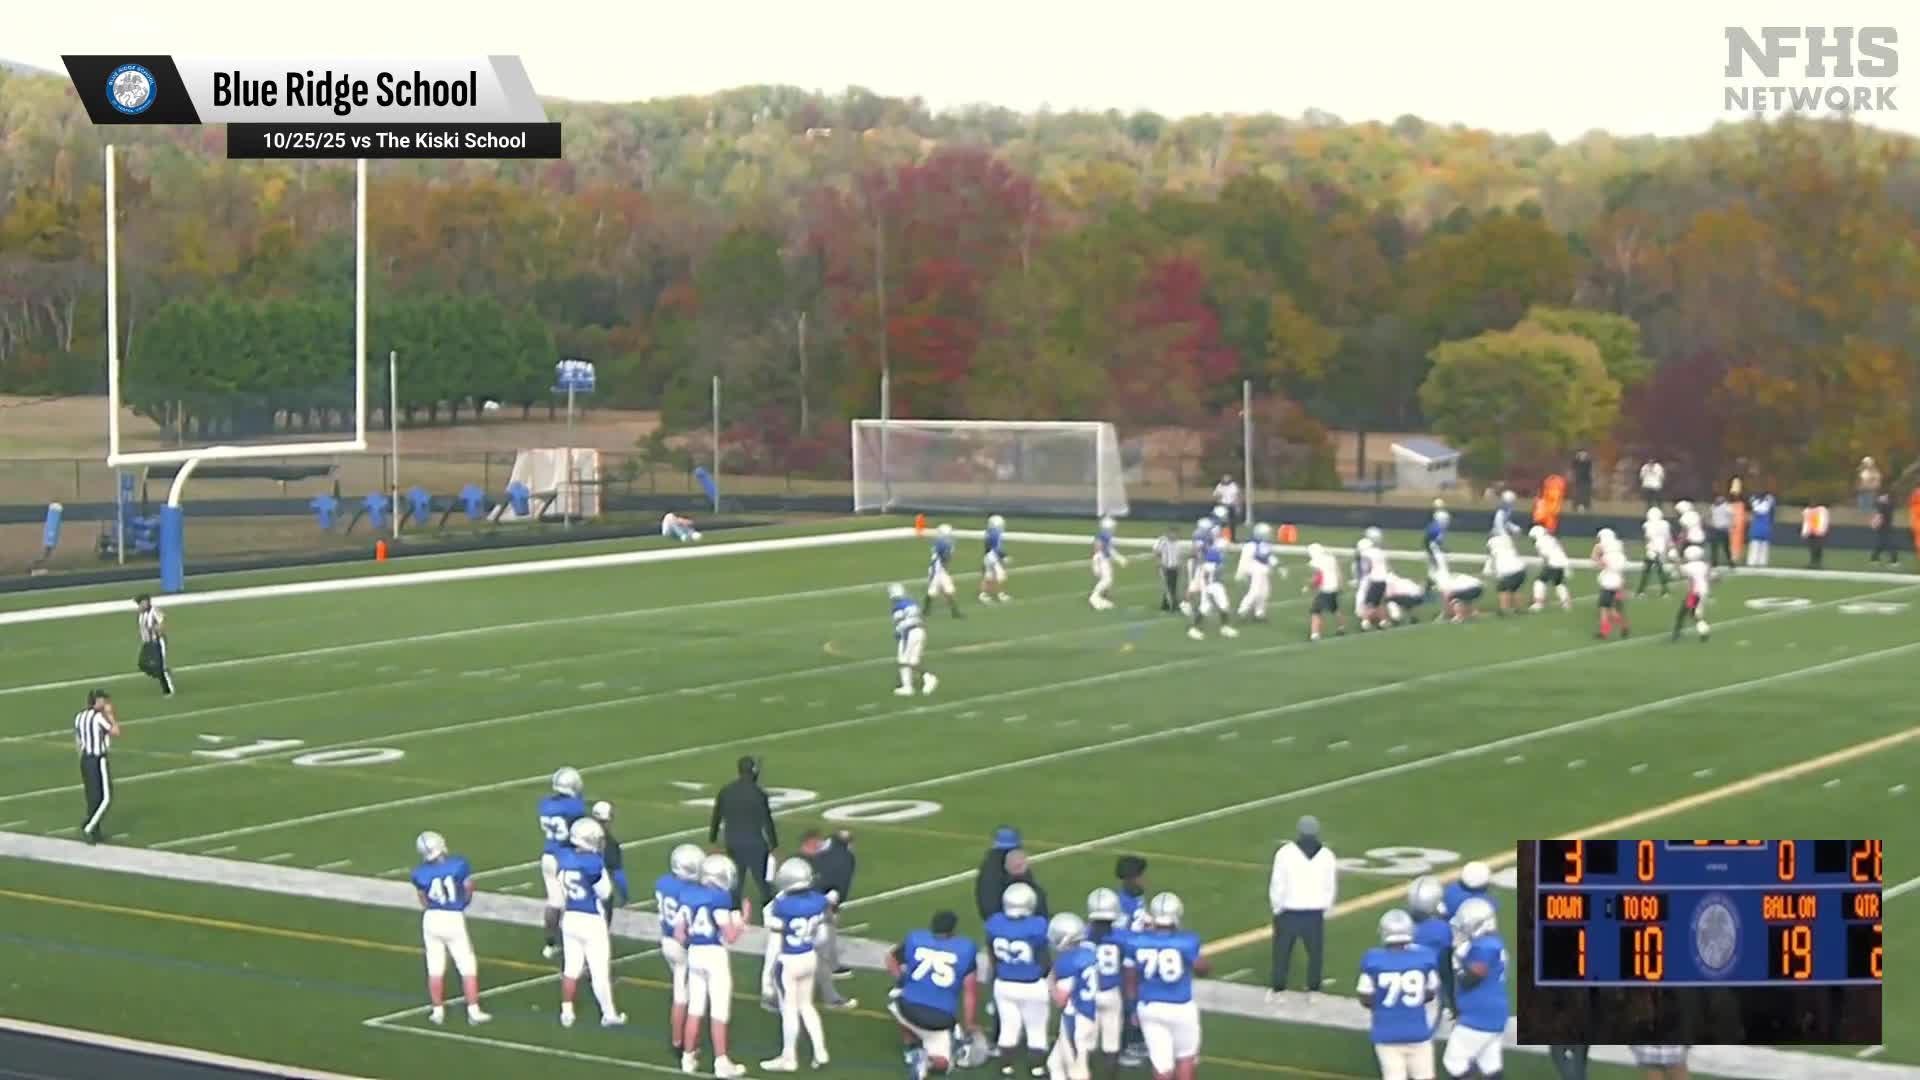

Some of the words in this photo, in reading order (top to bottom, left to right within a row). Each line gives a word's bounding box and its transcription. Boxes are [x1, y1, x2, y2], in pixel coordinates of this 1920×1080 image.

[1564, 840, 1583, 884] 3
[1637, 840, 1655, 882] 0
[1778, 840, 1795, 882] 0
[427, 875, 457, 905] 41
[1546, 895, 1583, 920] DOWN
[1623, 895, 1639, 920] TO
[1640, 895, 1659, 920] GO
[1763, 895, 1796, 920] BALL
[1798, 895, 1817, 920] ON
[1855, 893, 1879, 918] QTR
[911, 947, 957, 987] 75
[1136, 948, 1184, 984] 78
[1578, 929, 1586, 977] 1
[1634, 926, 1664, 980] 10
[1782, 926, 1812, 979] 19
[1378, 969, 1426, 1007] 79
